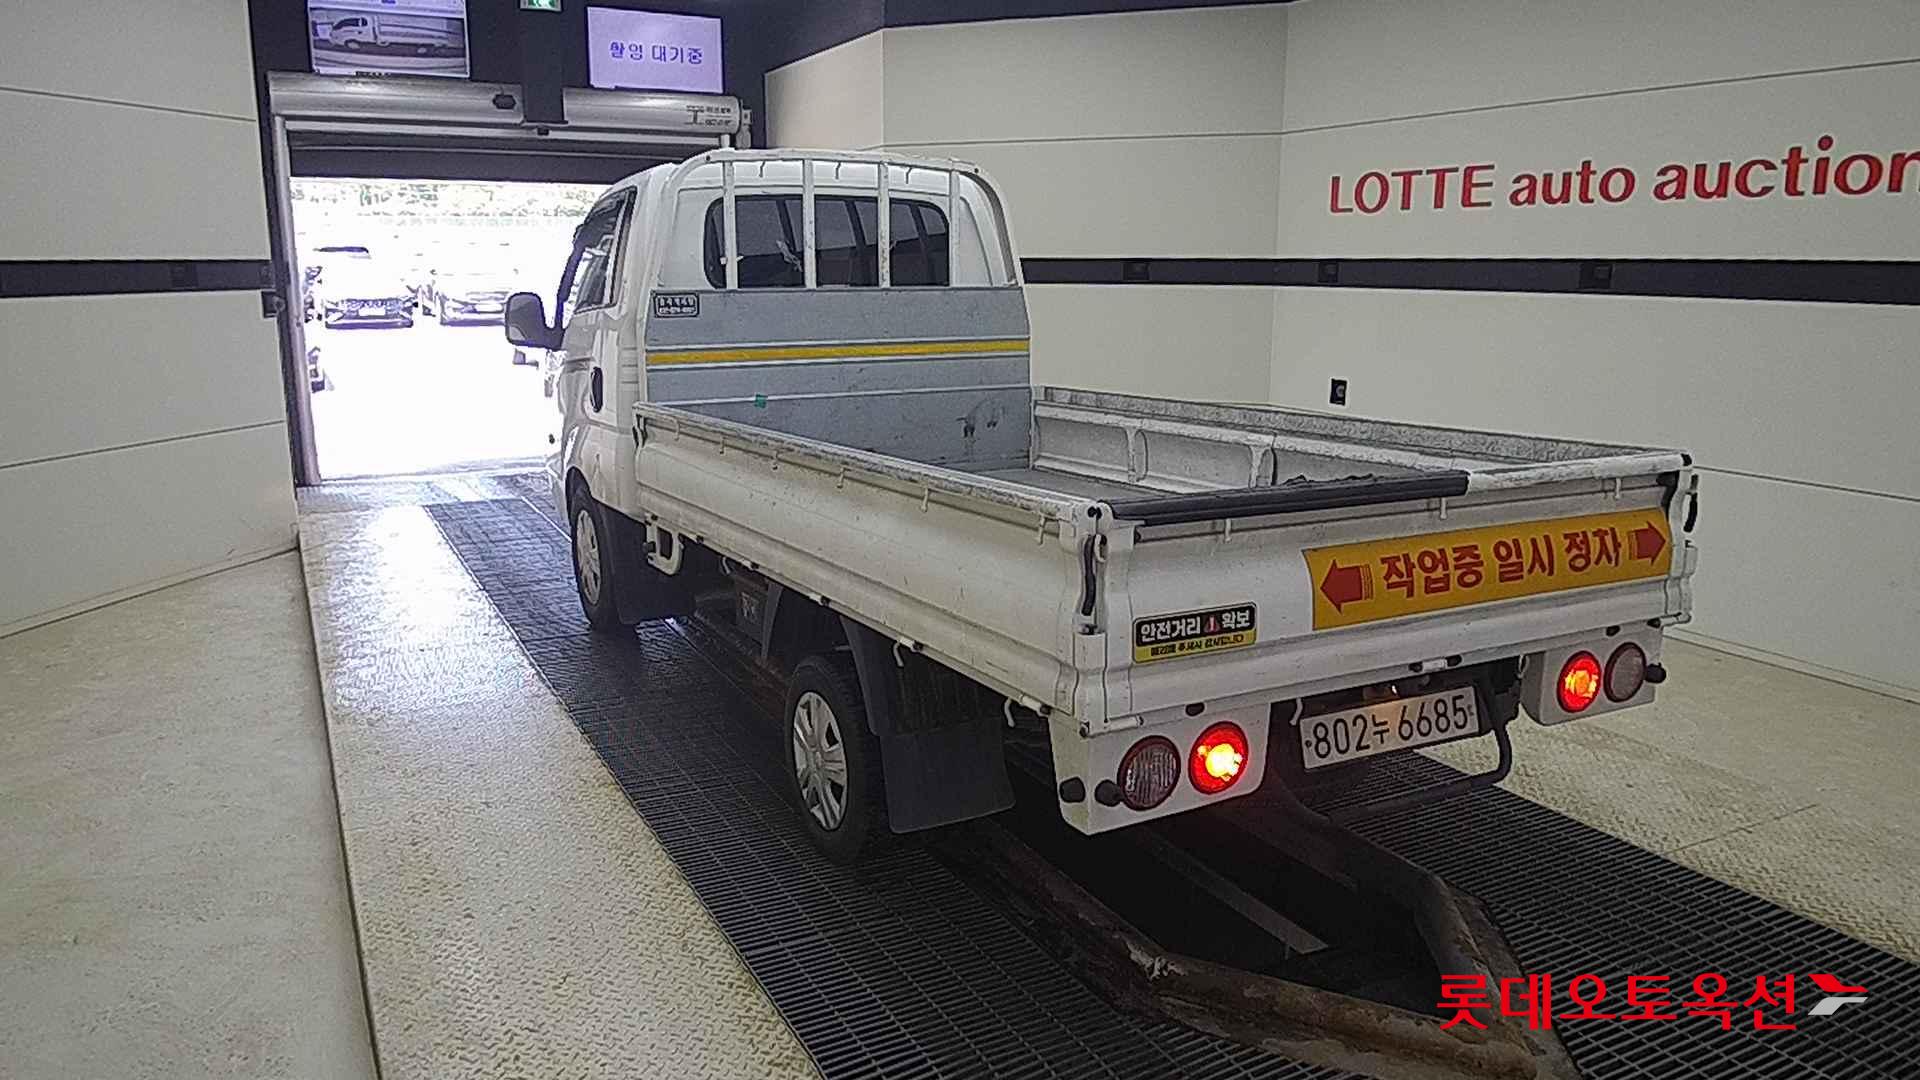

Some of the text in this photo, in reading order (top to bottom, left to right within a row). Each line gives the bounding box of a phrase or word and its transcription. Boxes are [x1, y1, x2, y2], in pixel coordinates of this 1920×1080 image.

[652, 44, 702, 65] 대기중
[1330, 135, 1920, 214] LOTTE auto auction
[1380, 527, 1622, 599] 작업중 일시 정차
[1141, 610, 1250, 642] 안전거리 확보
[1313, 695, 1467, 759] 802누 6685
